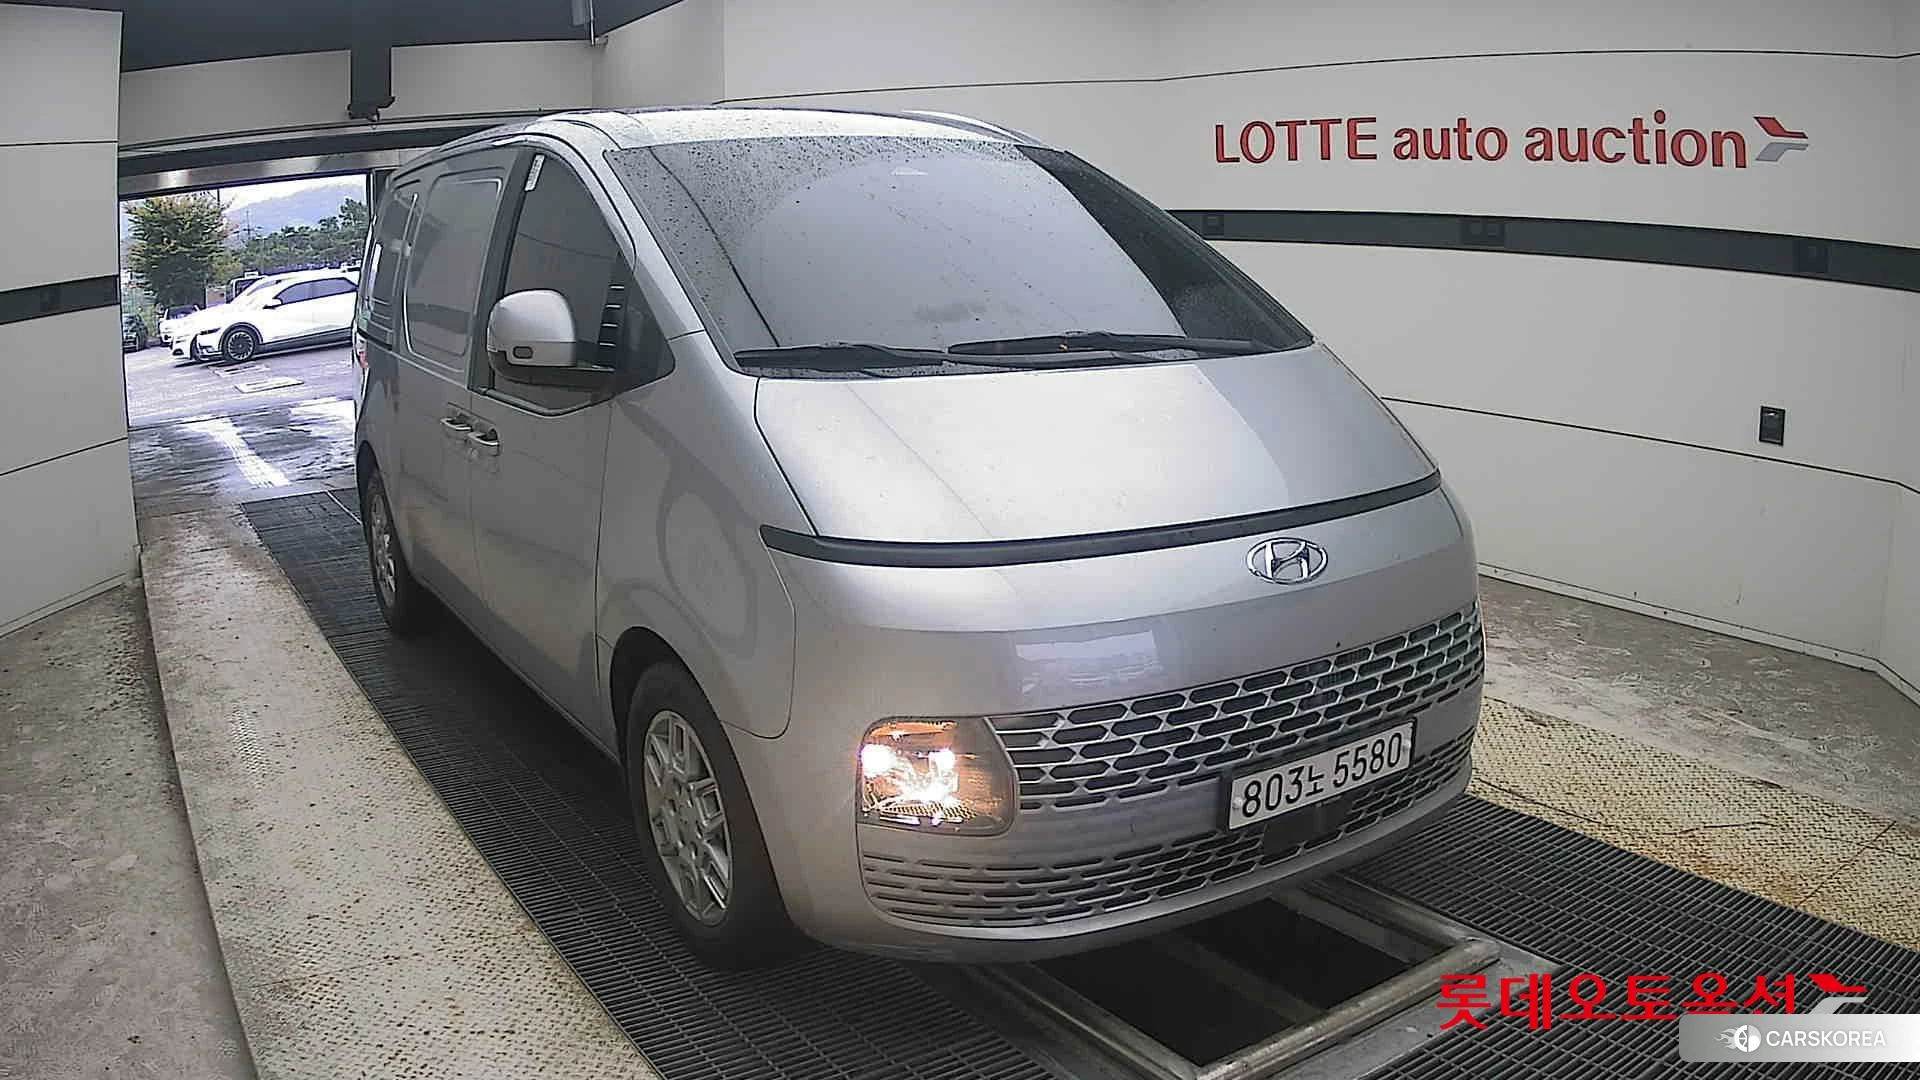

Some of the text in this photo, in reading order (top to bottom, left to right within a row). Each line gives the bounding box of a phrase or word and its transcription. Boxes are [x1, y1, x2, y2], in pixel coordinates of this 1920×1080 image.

[1215, 109, 1747, 169] LOTTE auto auction
[1242, 732, 1402, 818] 803노 5580
